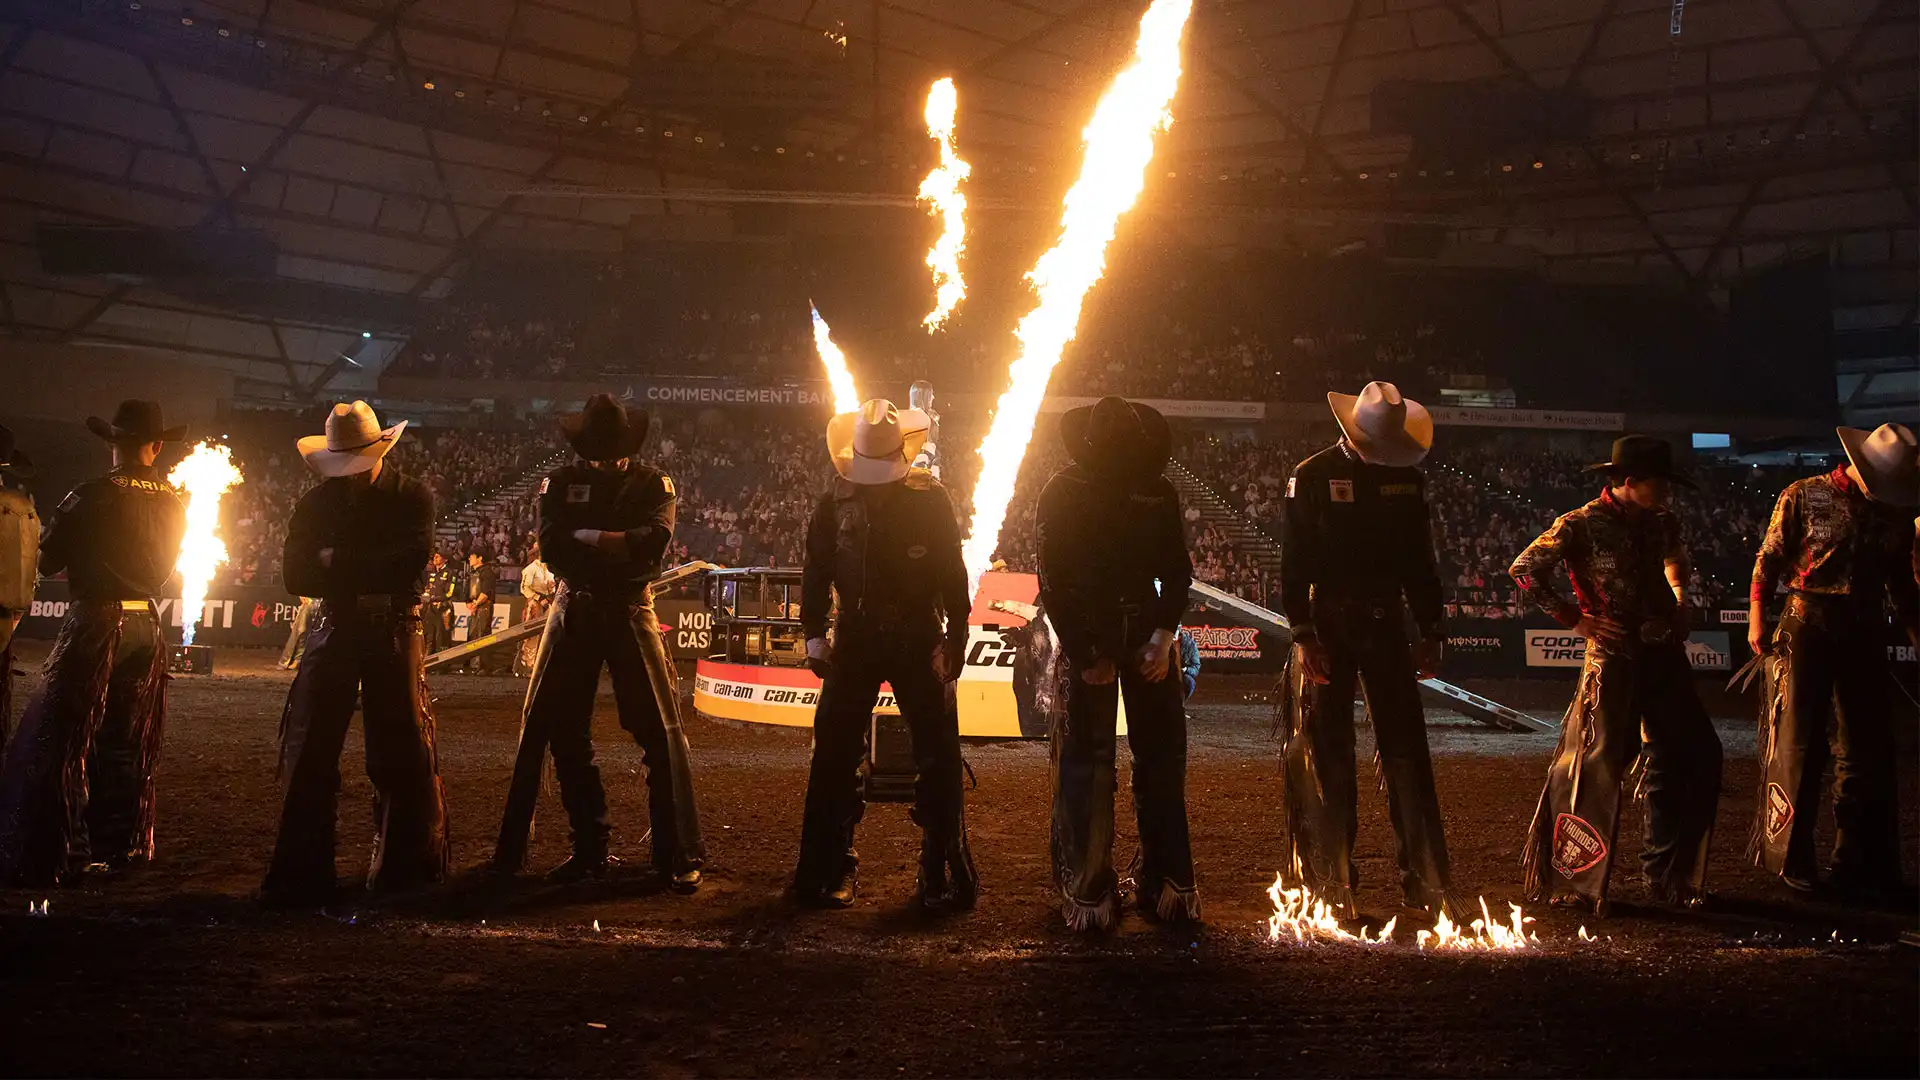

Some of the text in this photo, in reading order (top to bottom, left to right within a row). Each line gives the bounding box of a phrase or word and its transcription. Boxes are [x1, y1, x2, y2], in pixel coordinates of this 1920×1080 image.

[647, 387, 793, 404] COMMENCEMENT
[130, 479, 171, 493] ARIA
[1722, 612, 1747, 622] FLOOR
[1447, 636, 1501, 648] MONSTER
[714, 681, 753, 699] can-am
[764, 688, 818, 705] can-a
[1562, 818, 1600, 855] THUNDER
